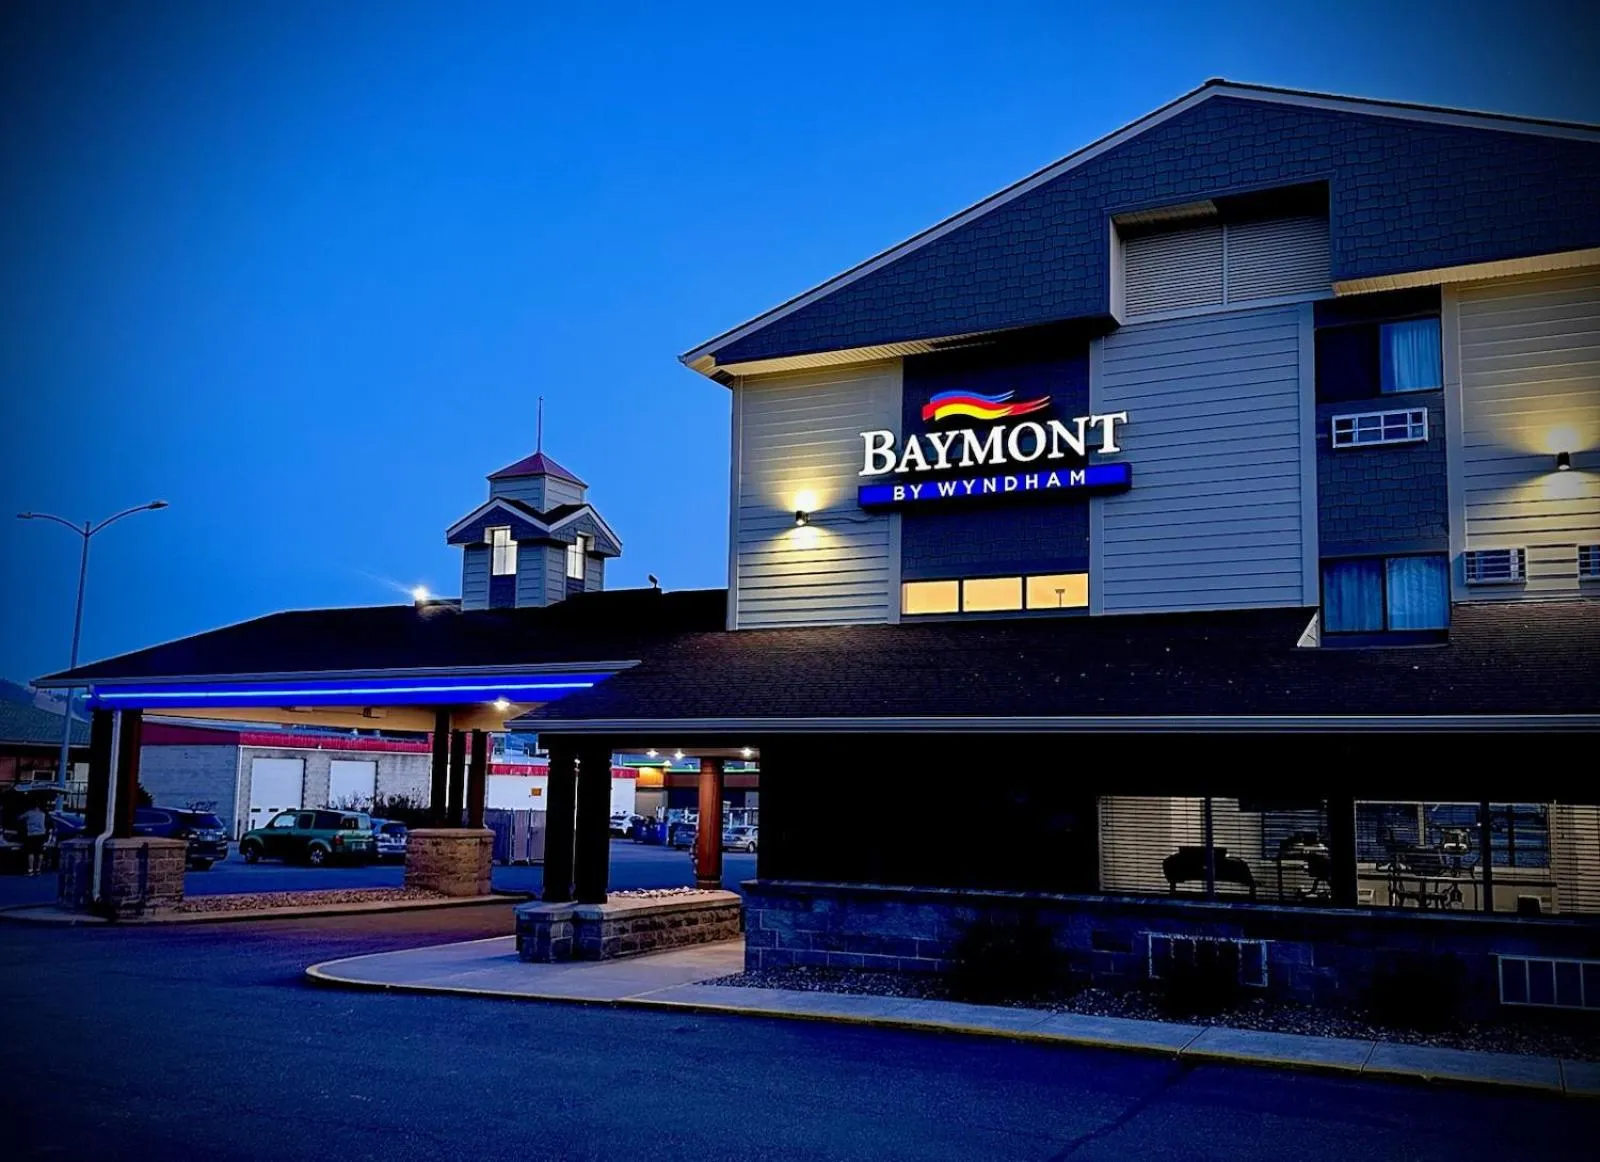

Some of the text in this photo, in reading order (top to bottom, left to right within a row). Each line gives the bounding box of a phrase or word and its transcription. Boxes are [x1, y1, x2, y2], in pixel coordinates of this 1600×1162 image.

[859, 411, 1128, 476] BAYMONT
[893, 469, 1086, 501] BY WYNDHAM
